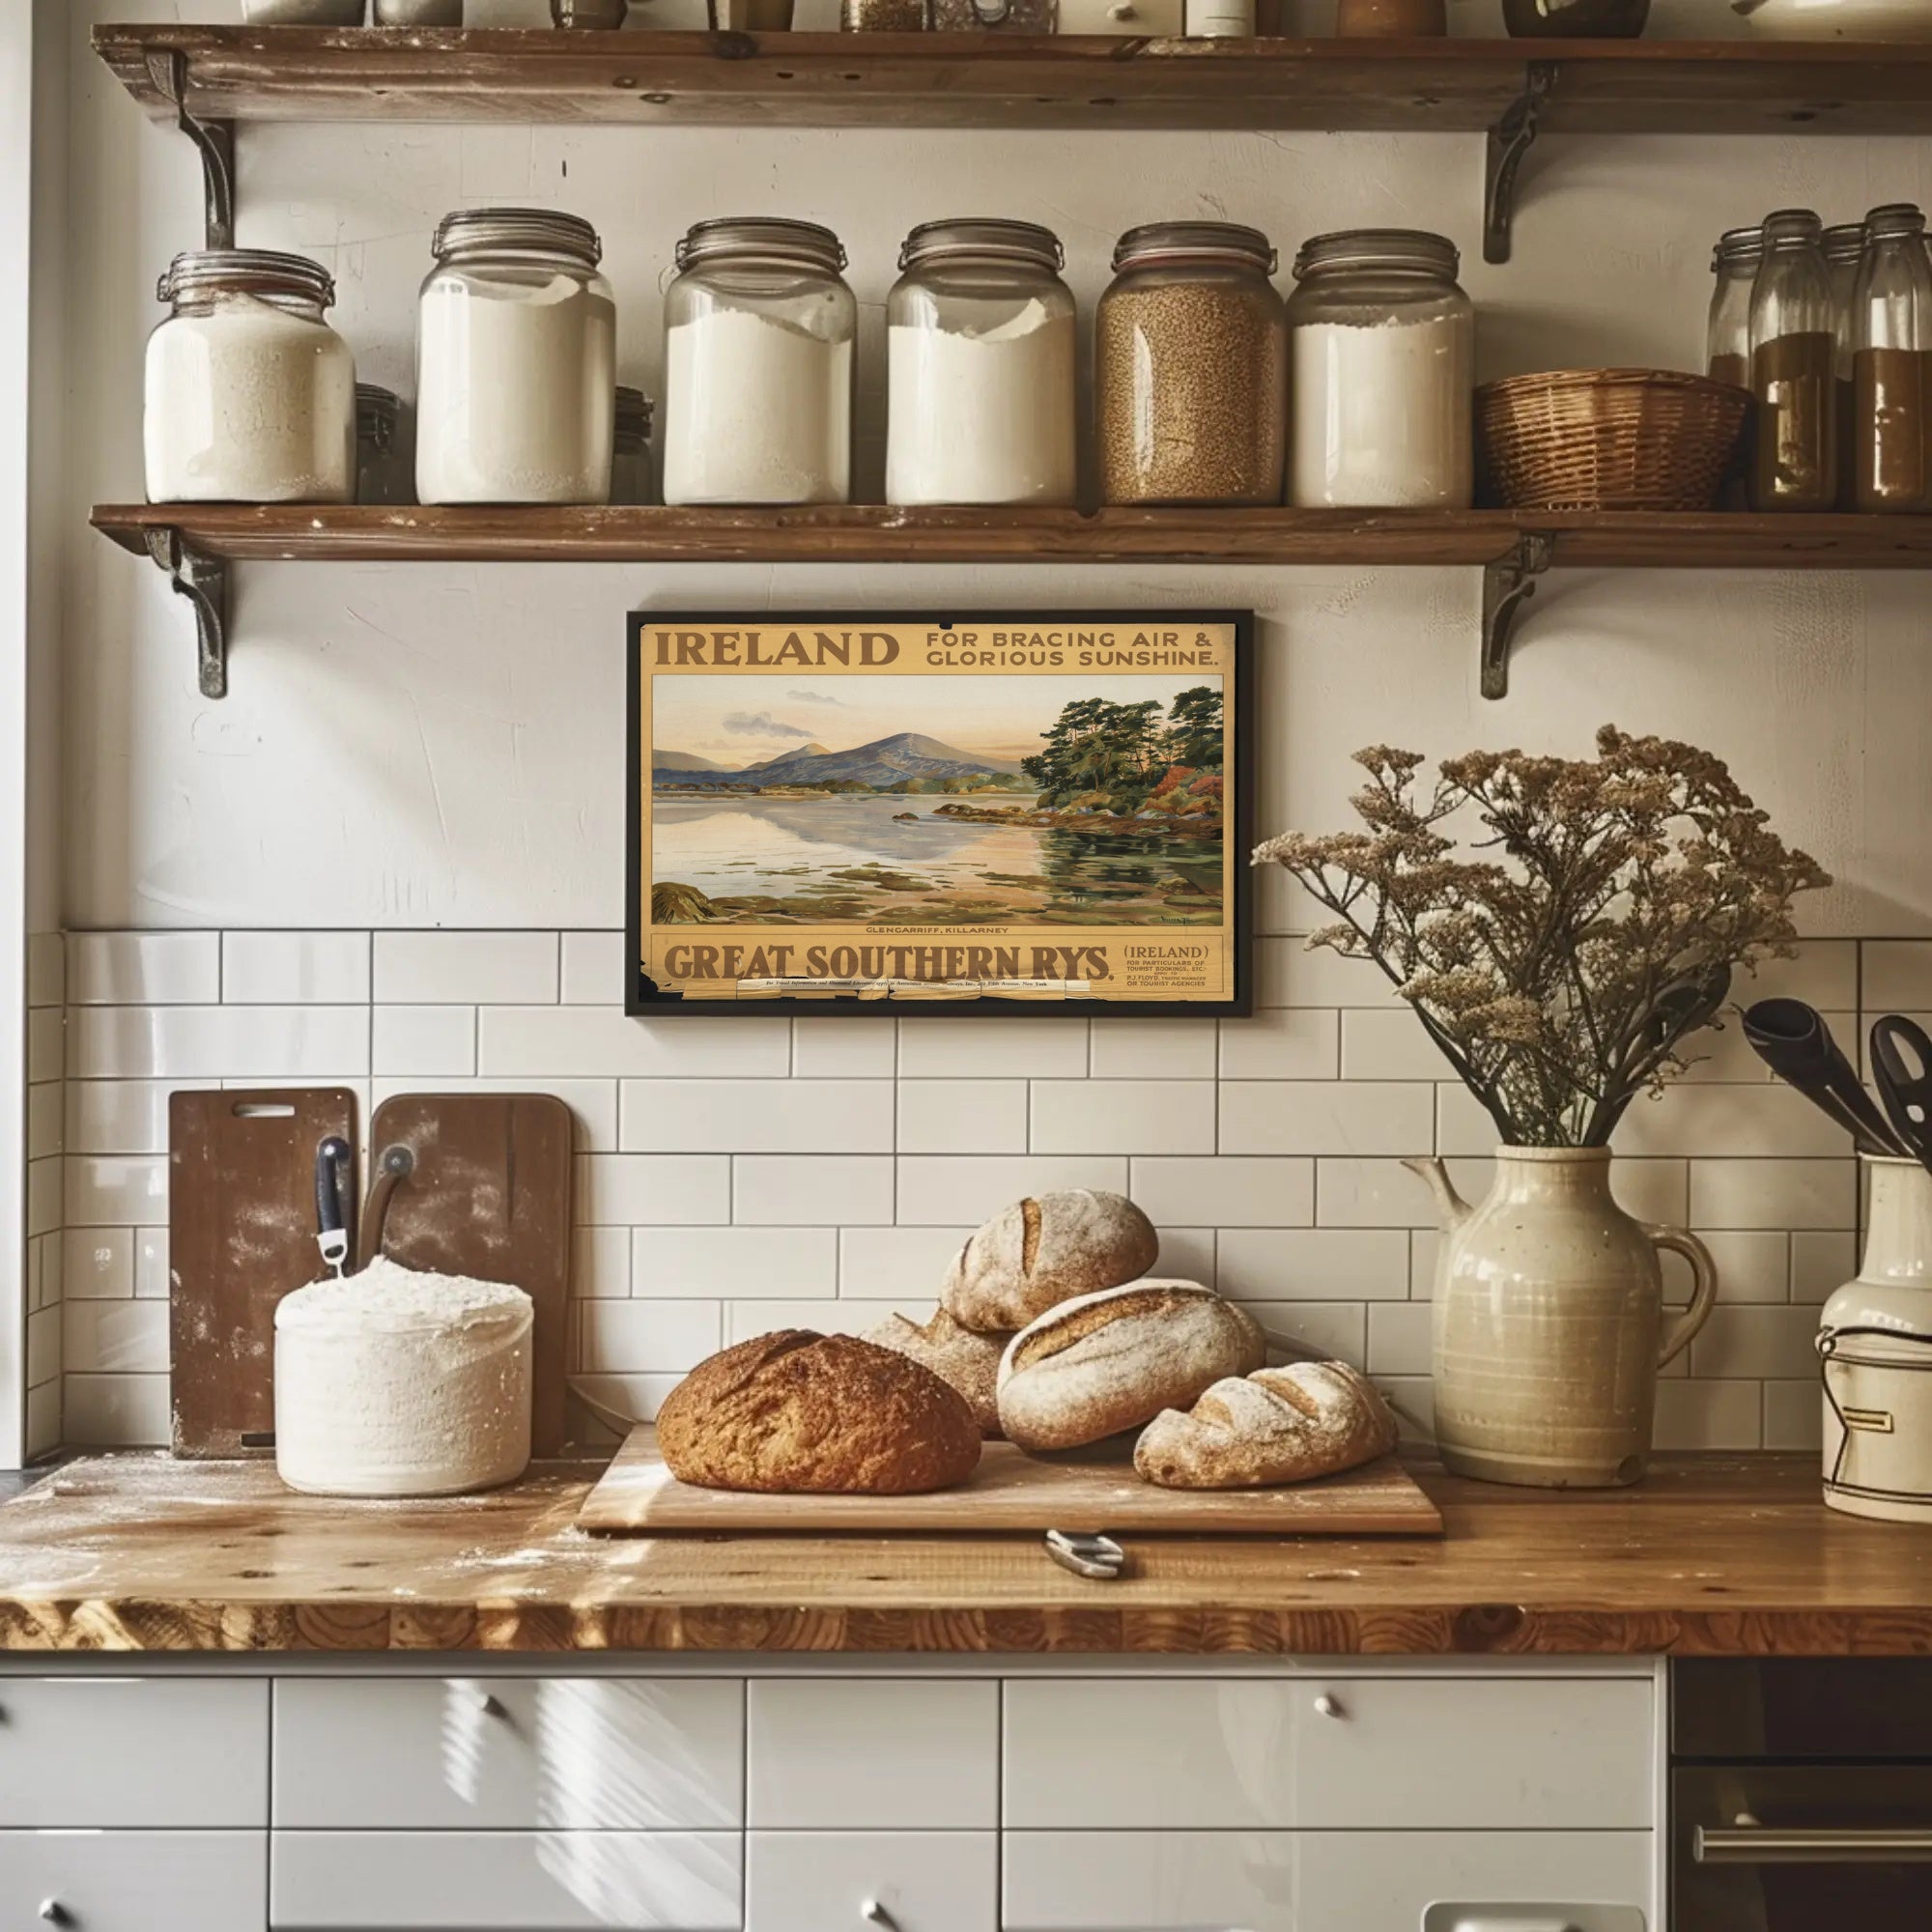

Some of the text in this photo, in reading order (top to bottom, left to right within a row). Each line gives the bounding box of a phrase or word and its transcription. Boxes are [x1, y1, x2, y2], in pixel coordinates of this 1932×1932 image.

[926, 632, 1212, 647] FOR BRACING AIR &
[655, 632, 899, 667] IRELAND
[925, 651, 1219, 667] GLORIOUS SUNSHINE.
[1123, 945, 1209, 959] (IRELAND)
[664, 945, 1115, 981] GREAT SOUTHERN RYS.
